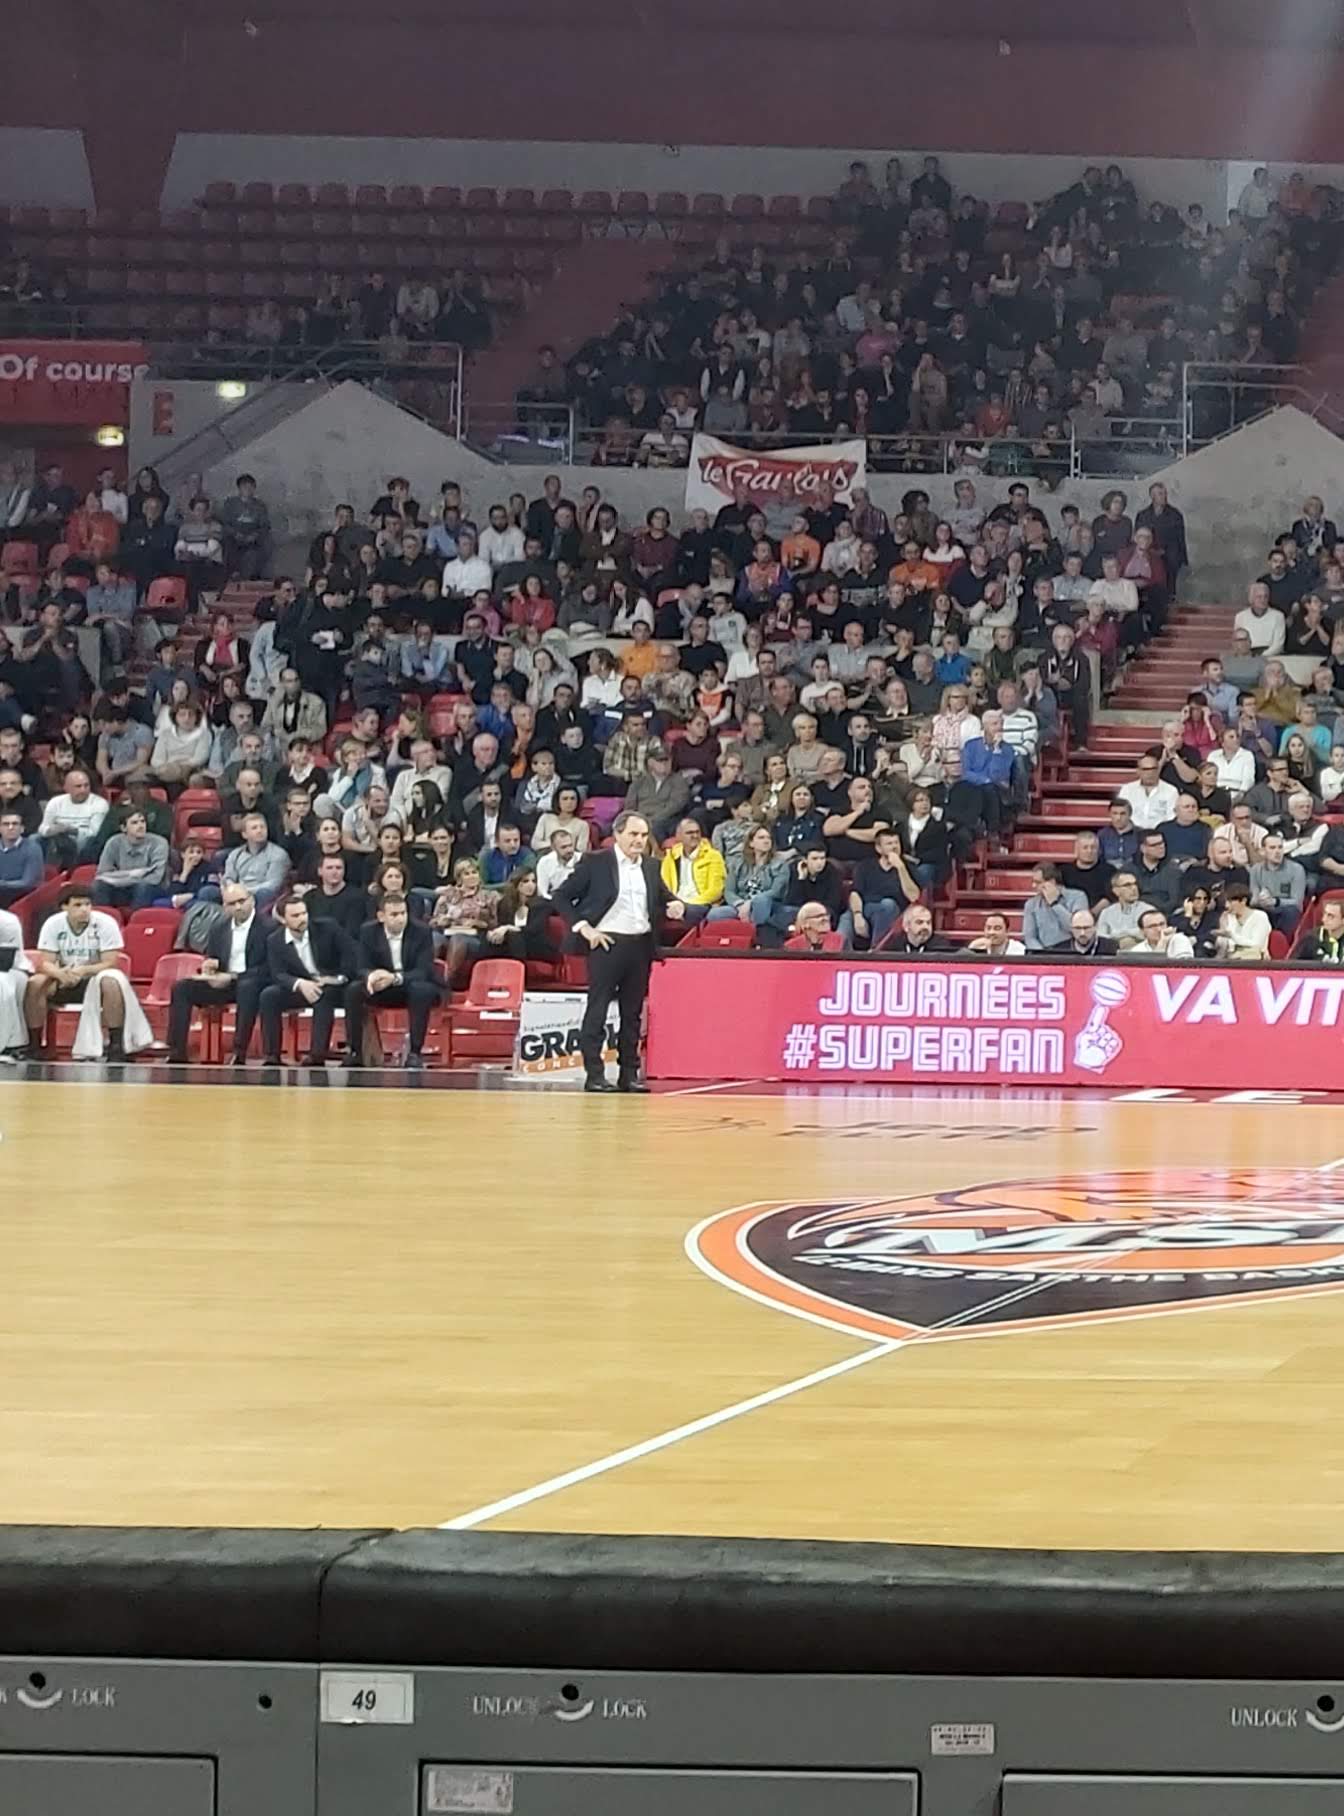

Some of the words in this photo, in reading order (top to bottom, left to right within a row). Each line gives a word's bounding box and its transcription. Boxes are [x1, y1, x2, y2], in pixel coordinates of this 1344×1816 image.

[818, 967, 1067, 1021] JOURNÉES
[1150, 973, 1240, 1025] VA
[782, 1022, 1066, 1075] #SUPERFAN
[1107, 1087, 1331, 1106] LE
[350, 1688, 378, 1712] 49
[1230, 1706, 1299, 1728] UNLOCK
